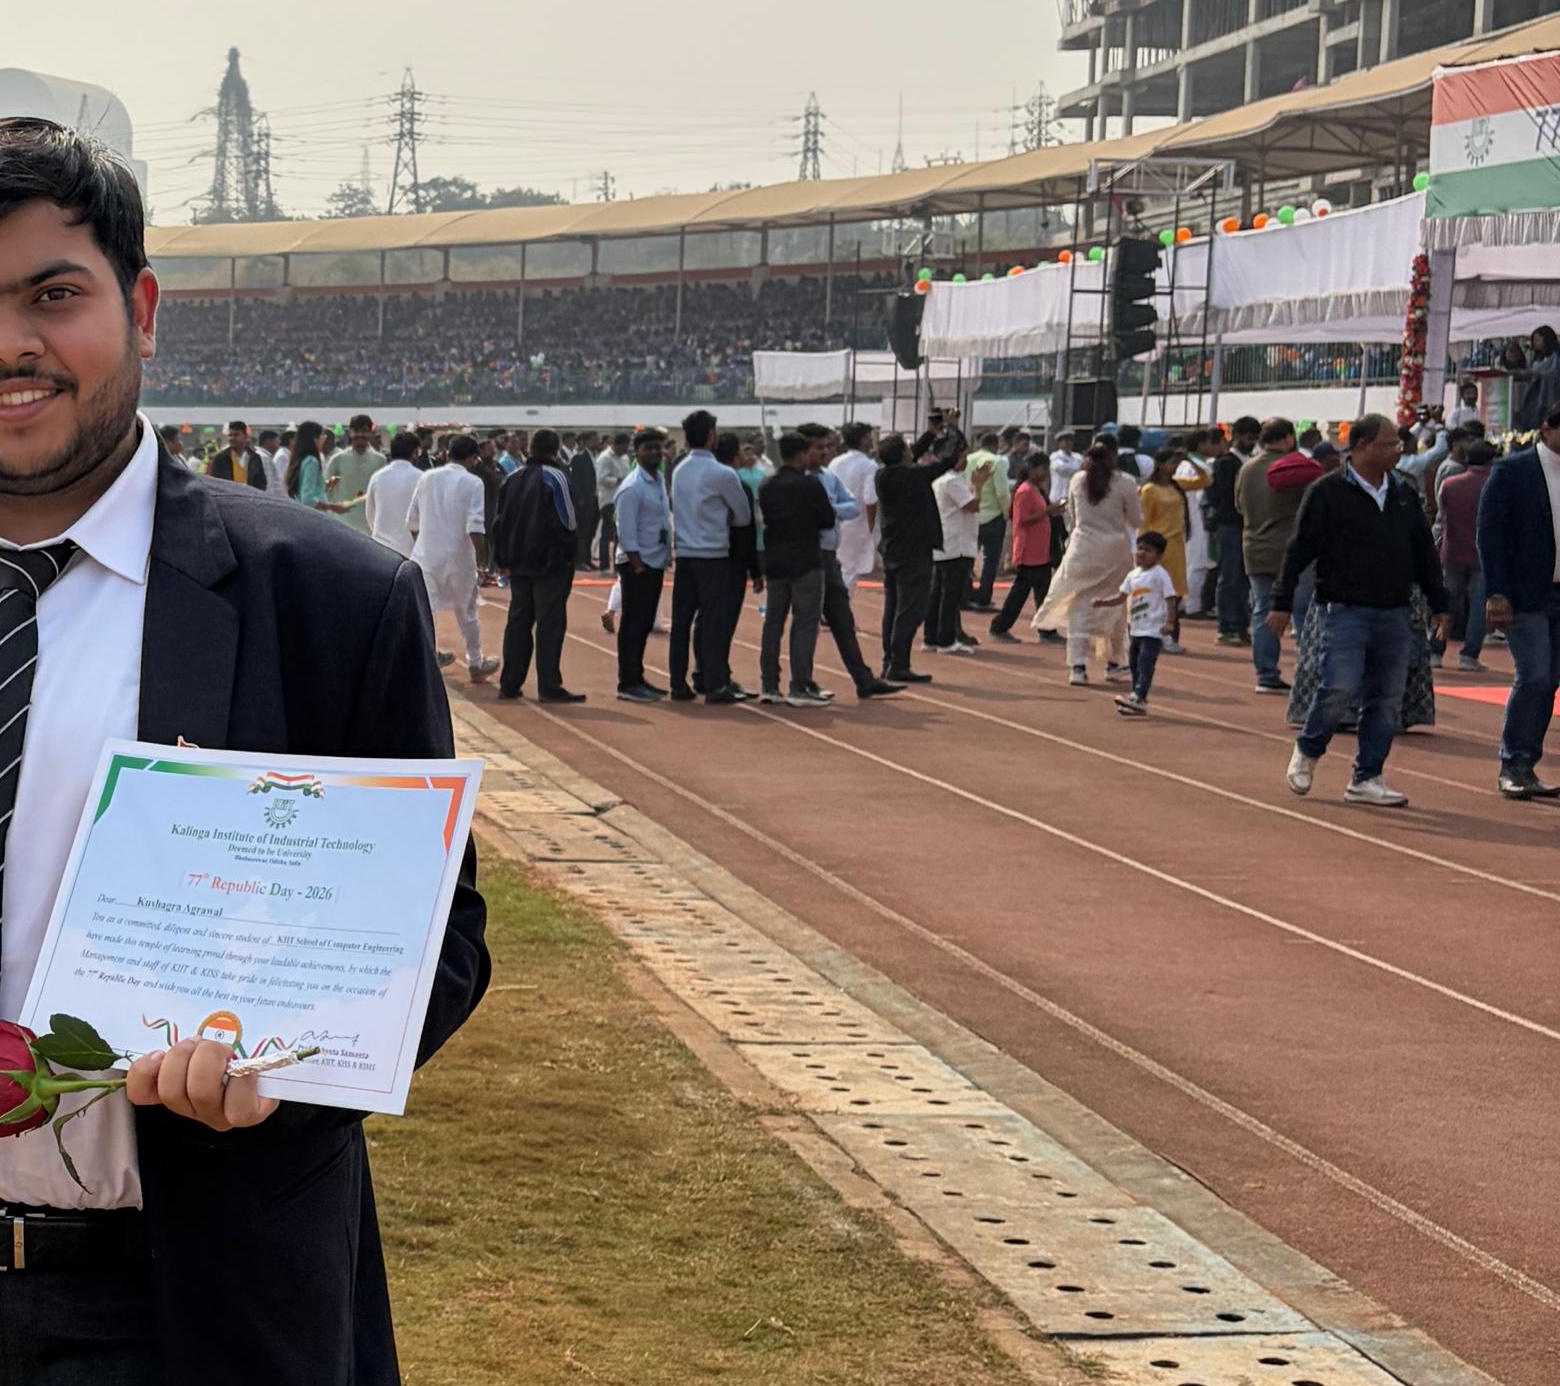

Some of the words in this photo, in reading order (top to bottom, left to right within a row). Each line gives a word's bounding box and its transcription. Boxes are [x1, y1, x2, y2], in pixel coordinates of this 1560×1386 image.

[171, 824, 210, 839] Kalinga
[212, 828, 255, 843] Institute
[257, 833, 268, 844] of
[269, 834, 318, 849] Industrial
[320, 837, 376, 854] Technology
[228, 843, 256, 854] Deemed
[258, 846, 265, 855] to
[267, 847, 275, 856] be
[277, 848, 312, 860] University
[211, 876, 266, 894] Republic
[269, 883, 294, 901] Day
[305, 885, 333, 900] 2026
[136, 896, 182, 912] Kushagra
[183, 903, 223, 917] Agrawal
[277, 935, 294, 944] KIIT
[296, 936, 318, 946] School
[319, 938, 327, 950] of
[327, 939, 361, 951] Computer
[362, 942, 405, 956] Engineering
[170, 963, 188, 973] KIIT
[200, 967, 220, 978] KISS
[340, 1048, 369, 1060] Samanta
[337, 1060, 351, 1068] KISS
